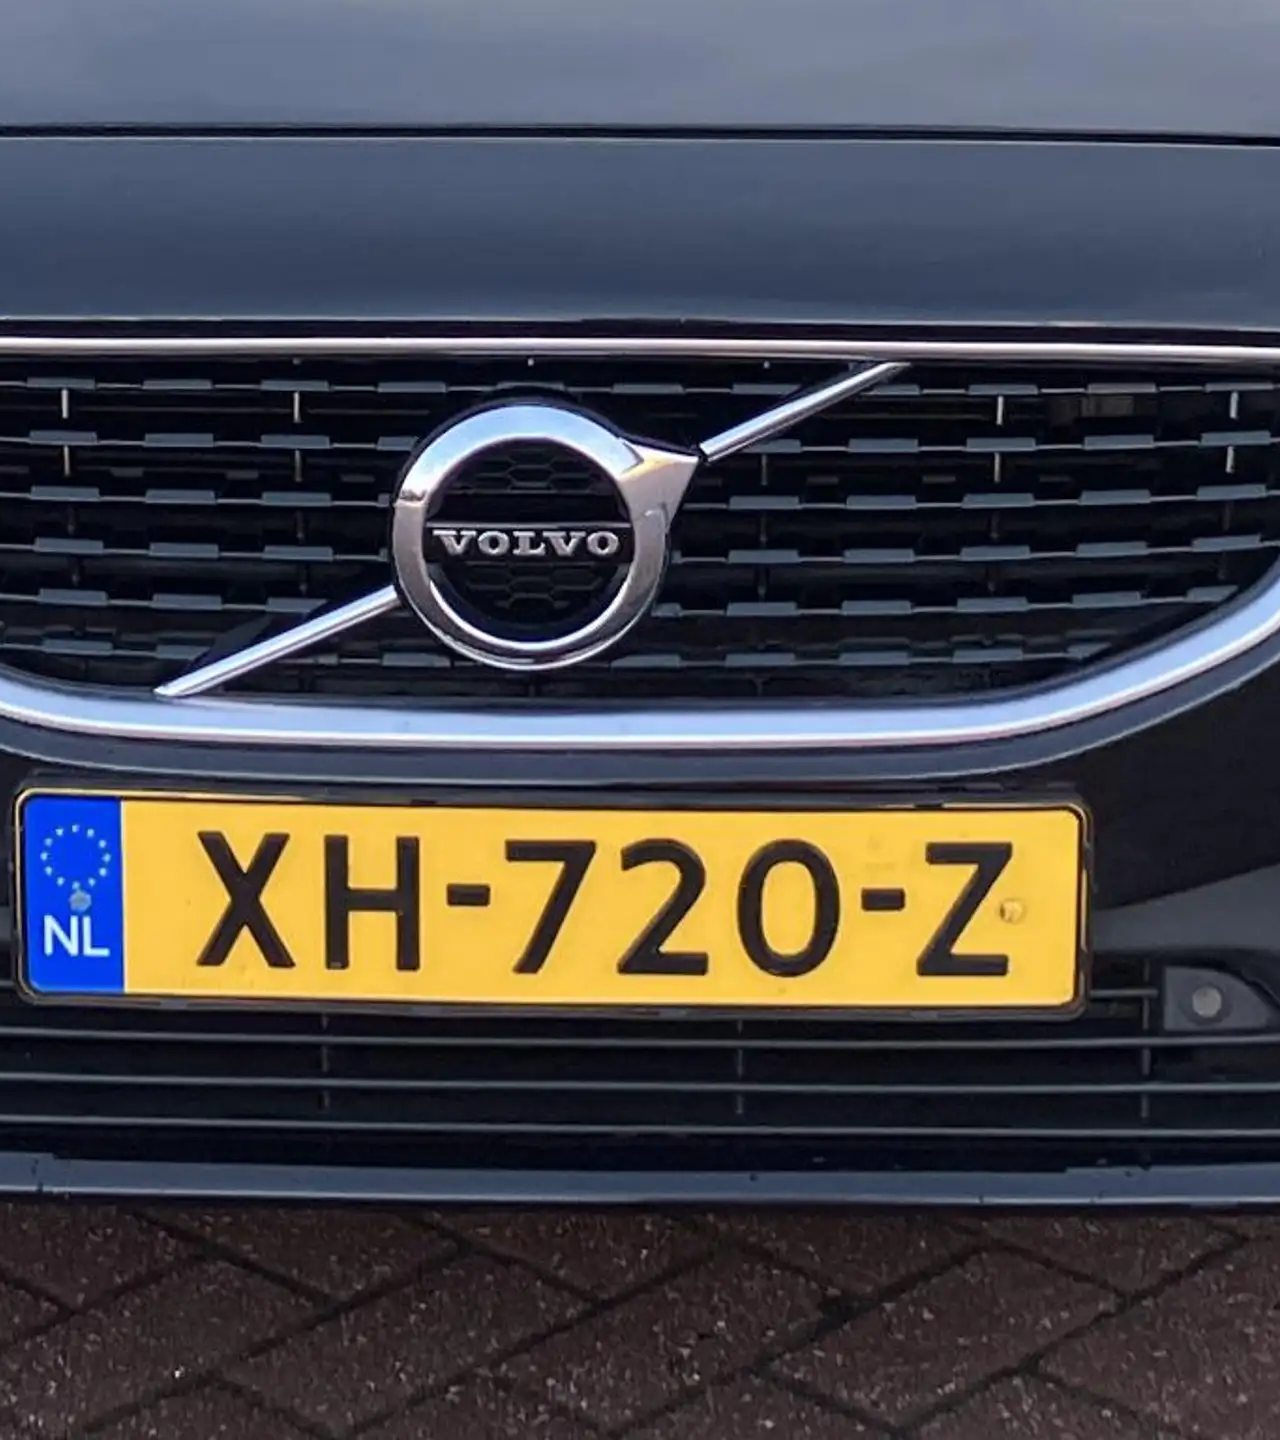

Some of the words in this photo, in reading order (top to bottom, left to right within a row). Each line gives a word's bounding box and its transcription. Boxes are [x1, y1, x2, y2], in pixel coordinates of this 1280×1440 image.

[432, 529, 620, 557] VOLVO
[195, 829, 1015, 978] XH-720-Z
[43, 914, 111, 958] NL
